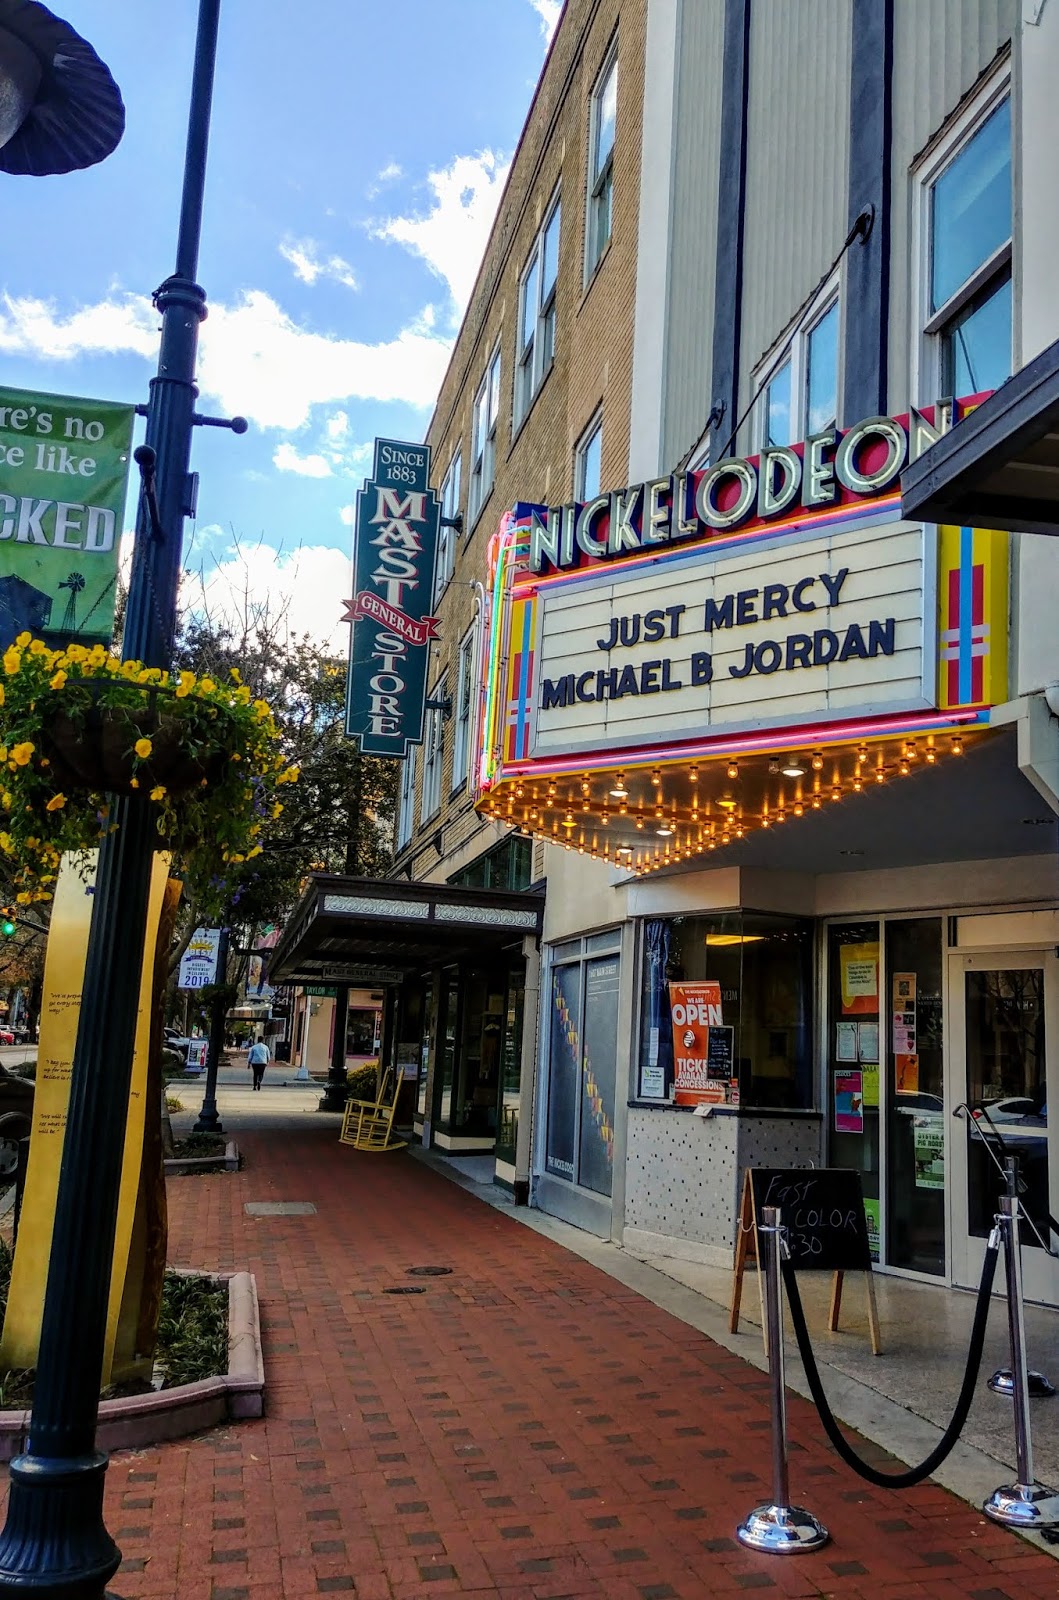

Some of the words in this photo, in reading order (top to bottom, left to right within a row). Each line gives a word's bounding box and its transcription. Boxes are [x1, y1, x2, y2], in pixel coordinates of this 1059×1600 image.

[63, 417, 105, 442] no
[34, 443, 97, 477] like
[381, 446, 425, 467] SINCE
[386, 465, 417, 485] 1883
[530, 397, 956, 573] NICKELODEON
[368, 486, 428, 609] MAST
[361, 595, 424, 643] GENERAL
[597, 604, 686, 651] JUST
[705, 568, 850, 632] MERCY
[541, 658, 682, 711] MICHAEL
[691, 651, 713, 687] B
[728, 618, 896, 680] JORDAN
[368, 632, 408, 736] STORE
[184, 975, 210, 987] 2019
[306, 986, 326, 995] TAYLOR
[671, 1003, 723, 1026] OPEN
[676, 1058, 708, 1073] TICKE
[678, 1071, 708, 1081] AVAILAB
[917, 1139, 927, 1147] PIG
[764, 1174, 818, 1207] Fast
[795, 1209, 858, 1234] COLOR
